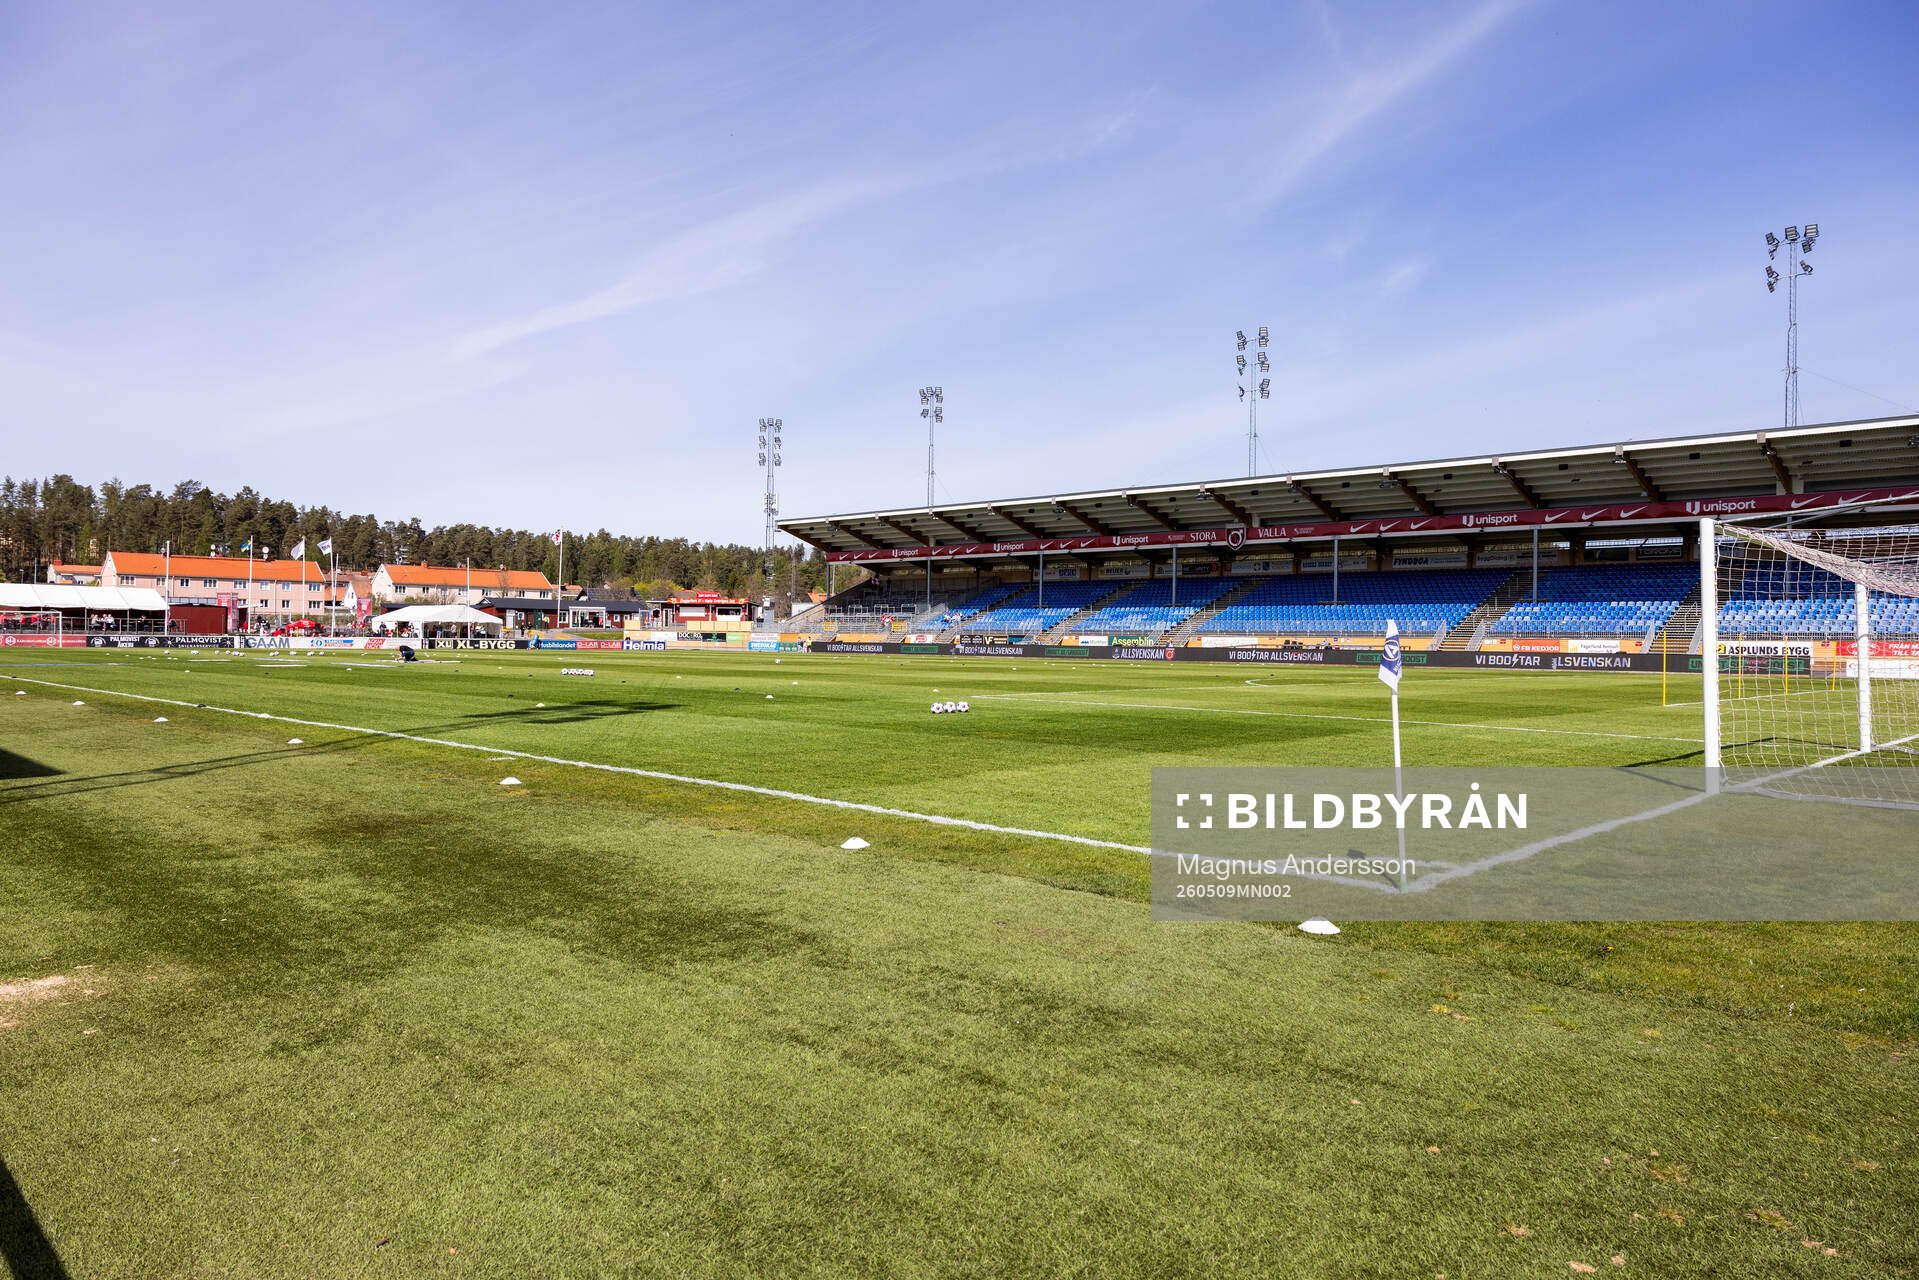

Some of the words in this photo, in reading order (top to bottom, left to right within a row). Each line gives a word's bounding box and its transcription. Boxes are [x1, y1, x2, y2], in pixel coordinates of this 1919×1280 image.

[1703, 499, 1756, 513] unisport
[1475, 513, 1518, 525] unisport
[1121, 535, 1149, 544] unisport
[1190, 532, 1217, 541] STORA
[1258, 528, 1287, 538] VALLA
[1000, 543, 1024, 551] unisport
[898, 549, 919, 557] unisport
[247, 637, 290, 648] GAAM
[457, 640, 516, 649] XL-BYGG
[623, 640, 665, 650] Helmia
[1112, 637, 1155, 647] Assemblin
[1121, 648, 1165, 659] ALLSVENSKAN
[1728, 646, 1778, 655] ASPLUNDS
[1782, 646, 1810, 655] BYGG
[1270, 651, 1323, 661] ALLSVENSKAN
[1475, 655, 1486, 664] VI
[1552, 656, 1631, 668] LSVENSKAN
